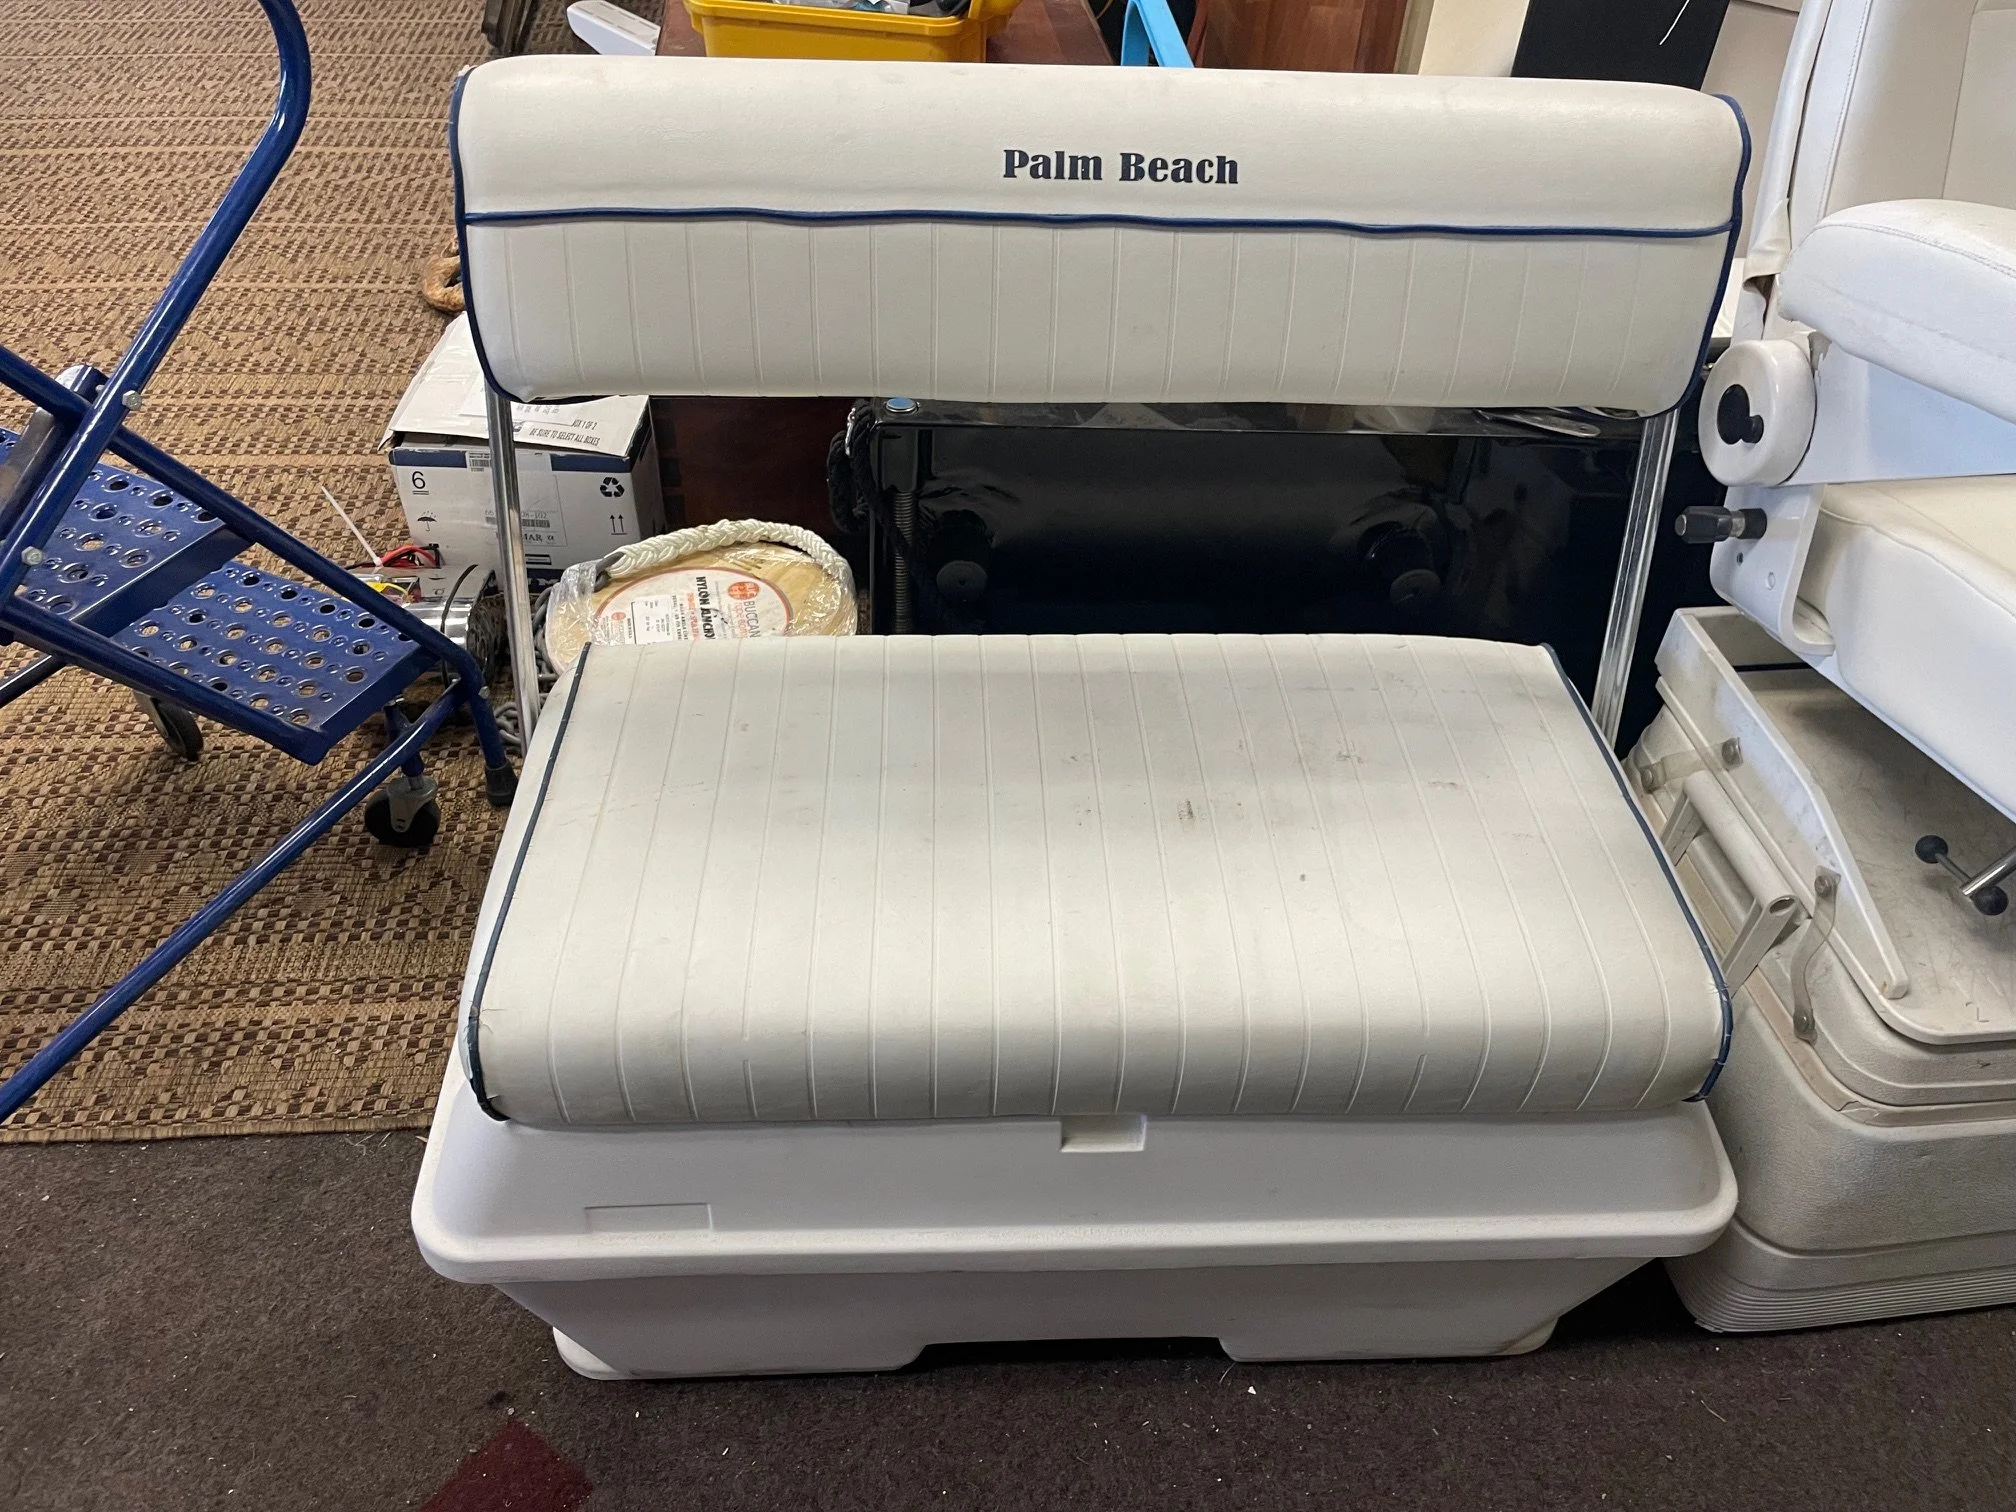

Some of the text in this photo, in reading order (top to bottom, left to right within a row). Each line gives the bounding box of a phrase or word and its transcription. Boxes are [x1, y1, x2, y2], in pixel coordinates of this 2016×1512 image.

[1003, 149, 1239, 184] Palm Beach
[536, 428, 551, 438] SURE
[550, 430, 558, 439] TO
[557, 431, 576, 441] SELECT
[575, 433, 585, 443] ALL
[583, 435, 601, 446] BOXES
[411, 470, 426, 489] 6
[696, 576, 711, 606] NYLON
[743, 600, 761, 638] BUCCAN
